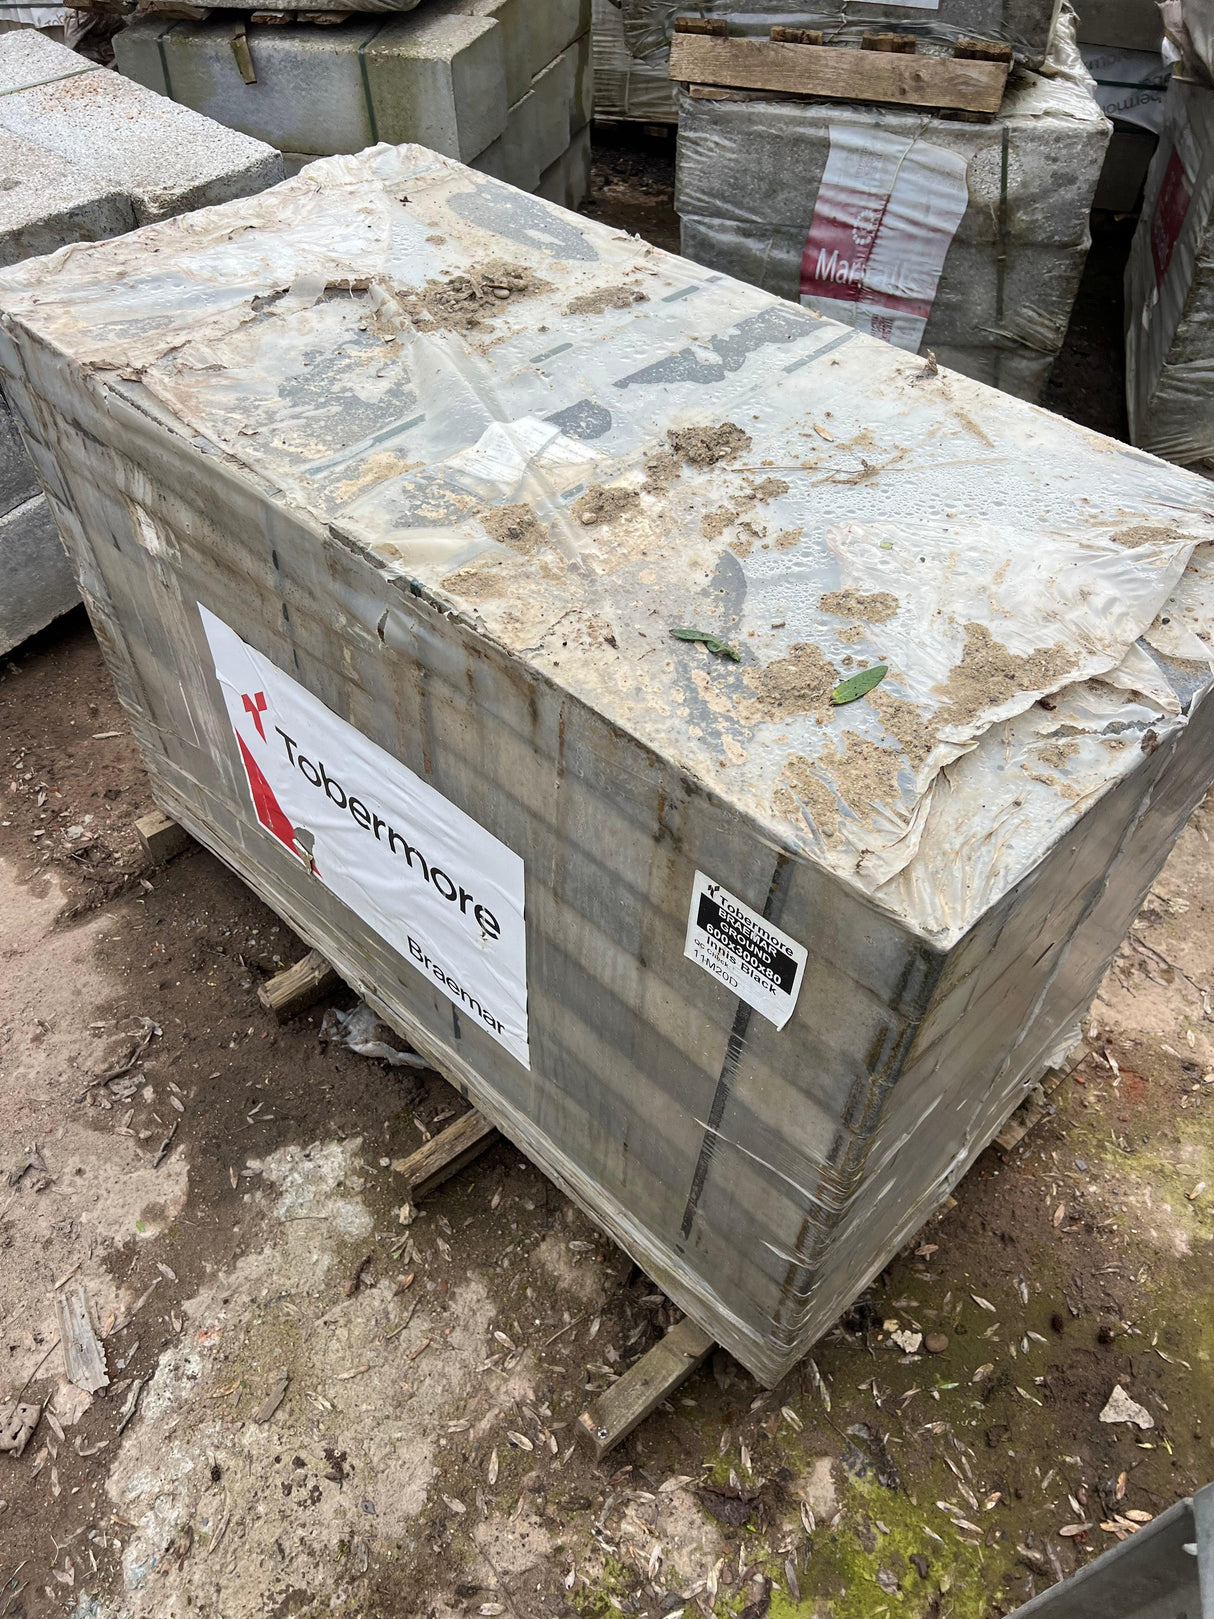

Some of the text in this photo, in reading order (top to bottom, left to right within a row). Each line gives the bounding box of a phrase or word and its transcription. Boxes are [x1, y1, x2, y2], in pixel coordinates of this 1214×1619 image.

[275, 726, 501, 941] Tobermore
[706, 923, 782, 985] 600x300x80
[718, 907, 777, 957] BRAEMAR
[719, 895, 794, 957] Tobermore
[720, 922, 772, 964] GROUND
[407, 935, 505, 1036] Braemar
[693, 949, 738, 988] 11M20D
[706, 936, 777, 996] Innis Black
